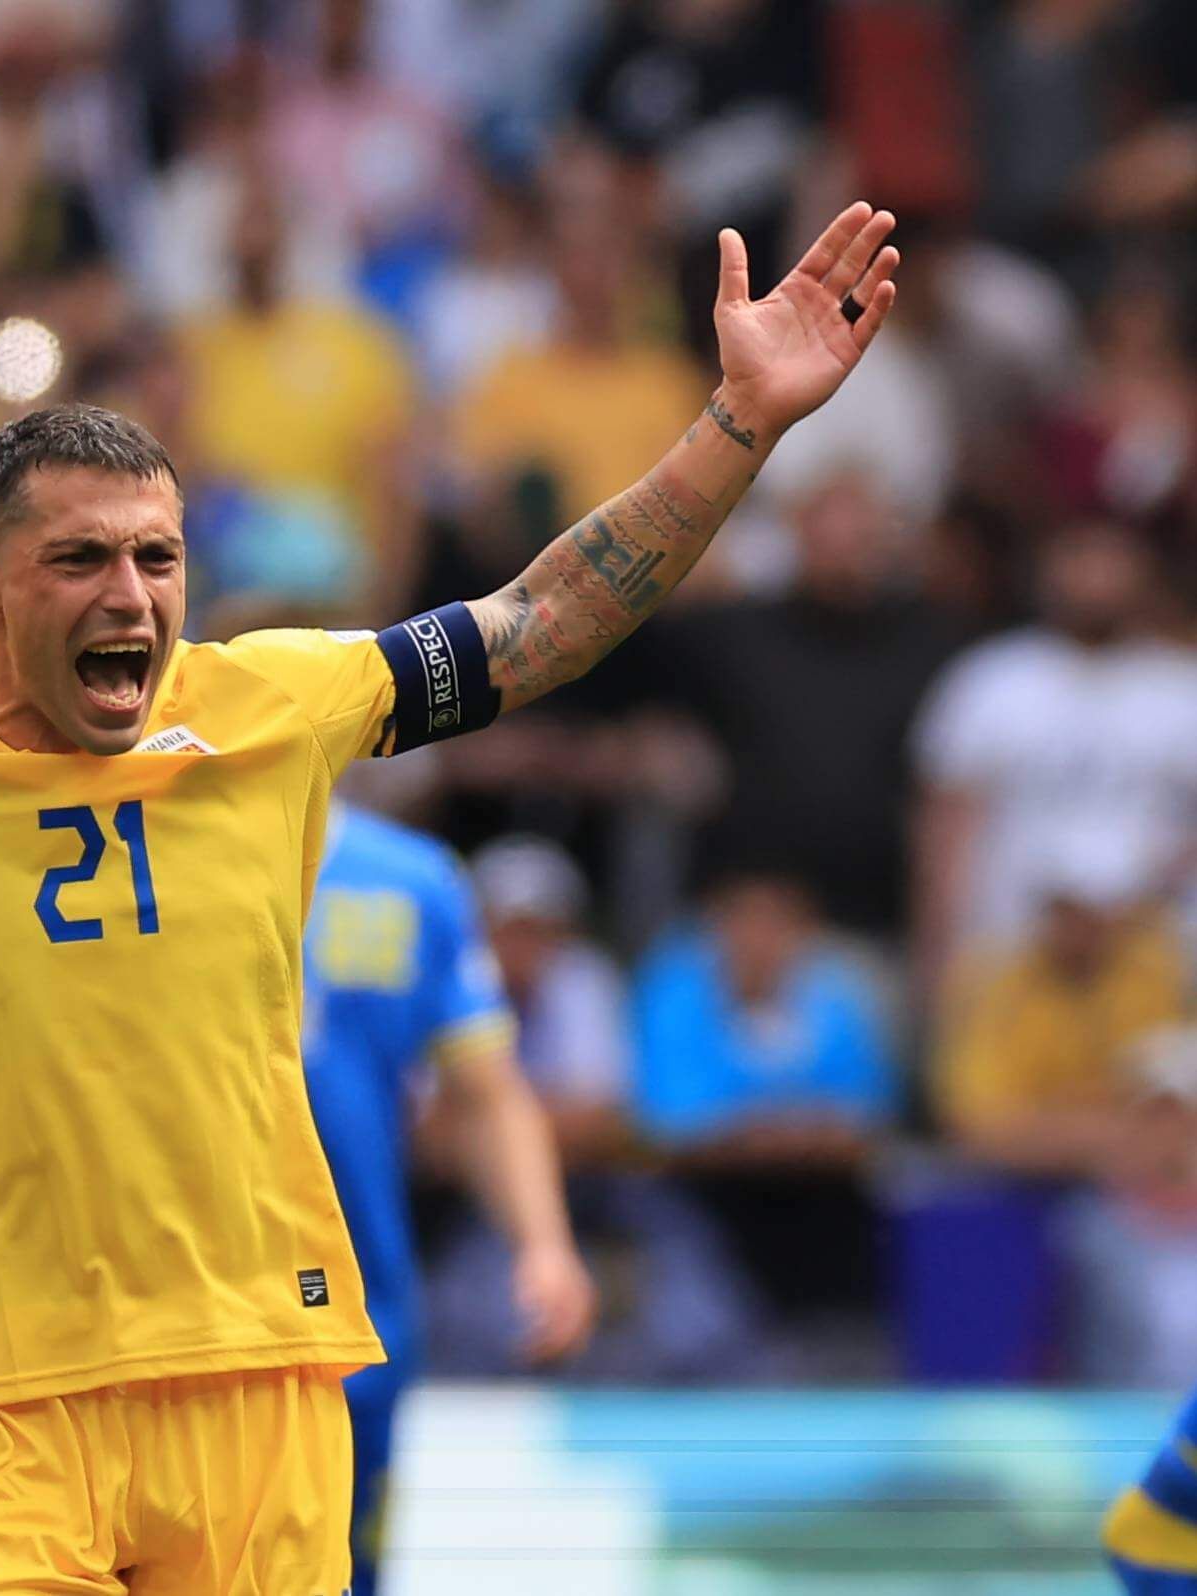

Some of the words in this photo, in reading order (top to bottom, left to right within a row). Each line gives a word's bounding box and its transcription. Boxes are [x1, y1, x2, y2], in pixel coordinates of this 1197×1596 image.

[410, 616, 453, 704] RESPECT
[141, 731, 187, 753] MANIA
[34, 799, 160, 944] 21
